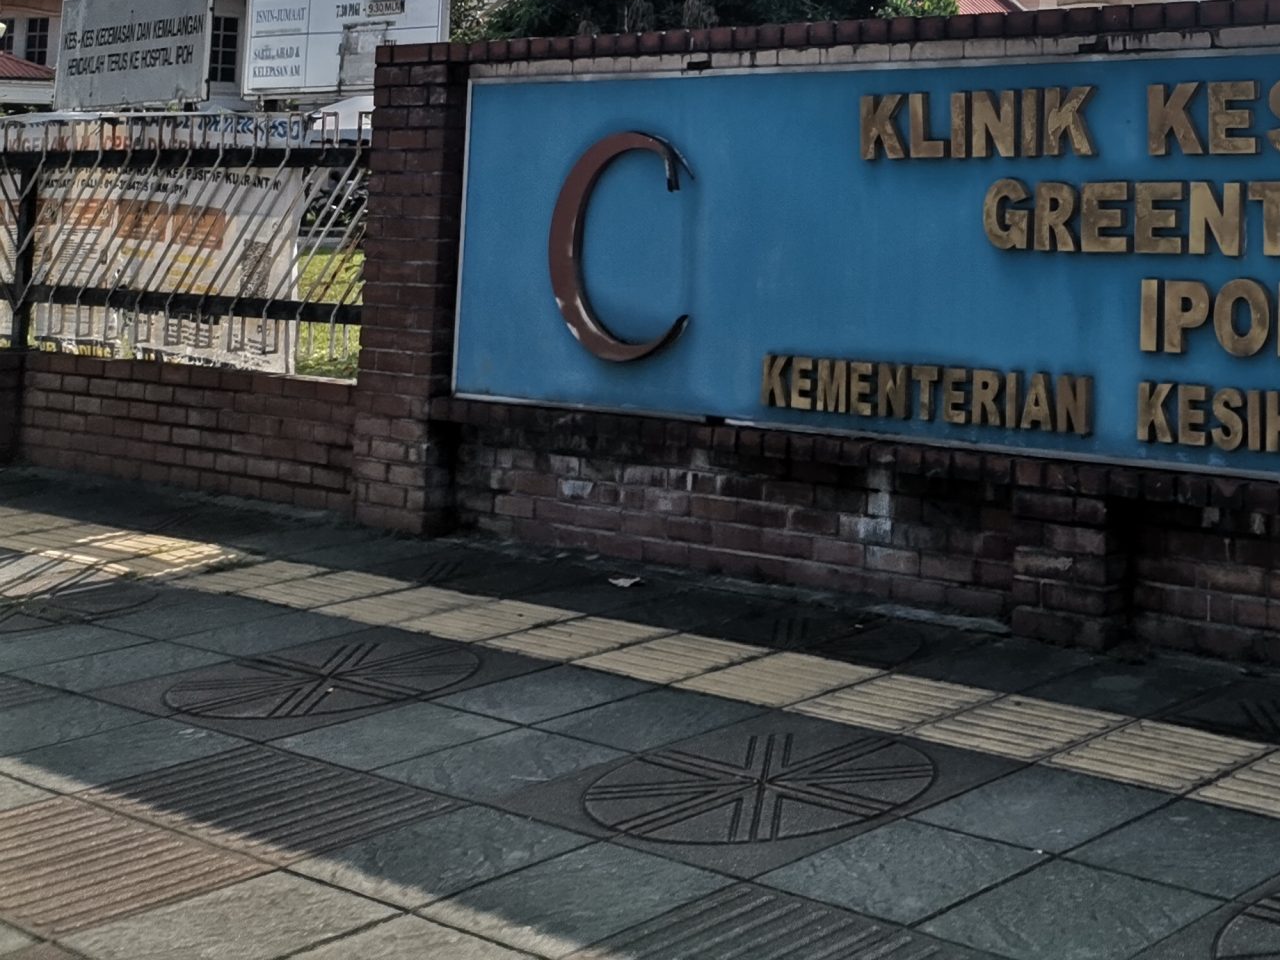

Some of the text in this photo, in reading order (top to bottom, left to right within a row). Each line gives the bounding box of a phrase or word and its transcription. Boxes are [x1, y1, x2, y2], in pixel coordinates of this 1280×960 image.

[95, 22, 136, 46] KECEMASAN
[136, 20, 152, 41] DAN
[153, 14, 204, 39] KEMALANGAN
[107, 52, 128, 72] TERUS
[129, 50, 140, 70] KE
[141, 47, 173, 68] HOSPITAL
[175, 44, 194, 65] IPOH
[859, 84, 1096, 161] KLINIK
[761, 352, 1094, 438] KEMENTERIAN
